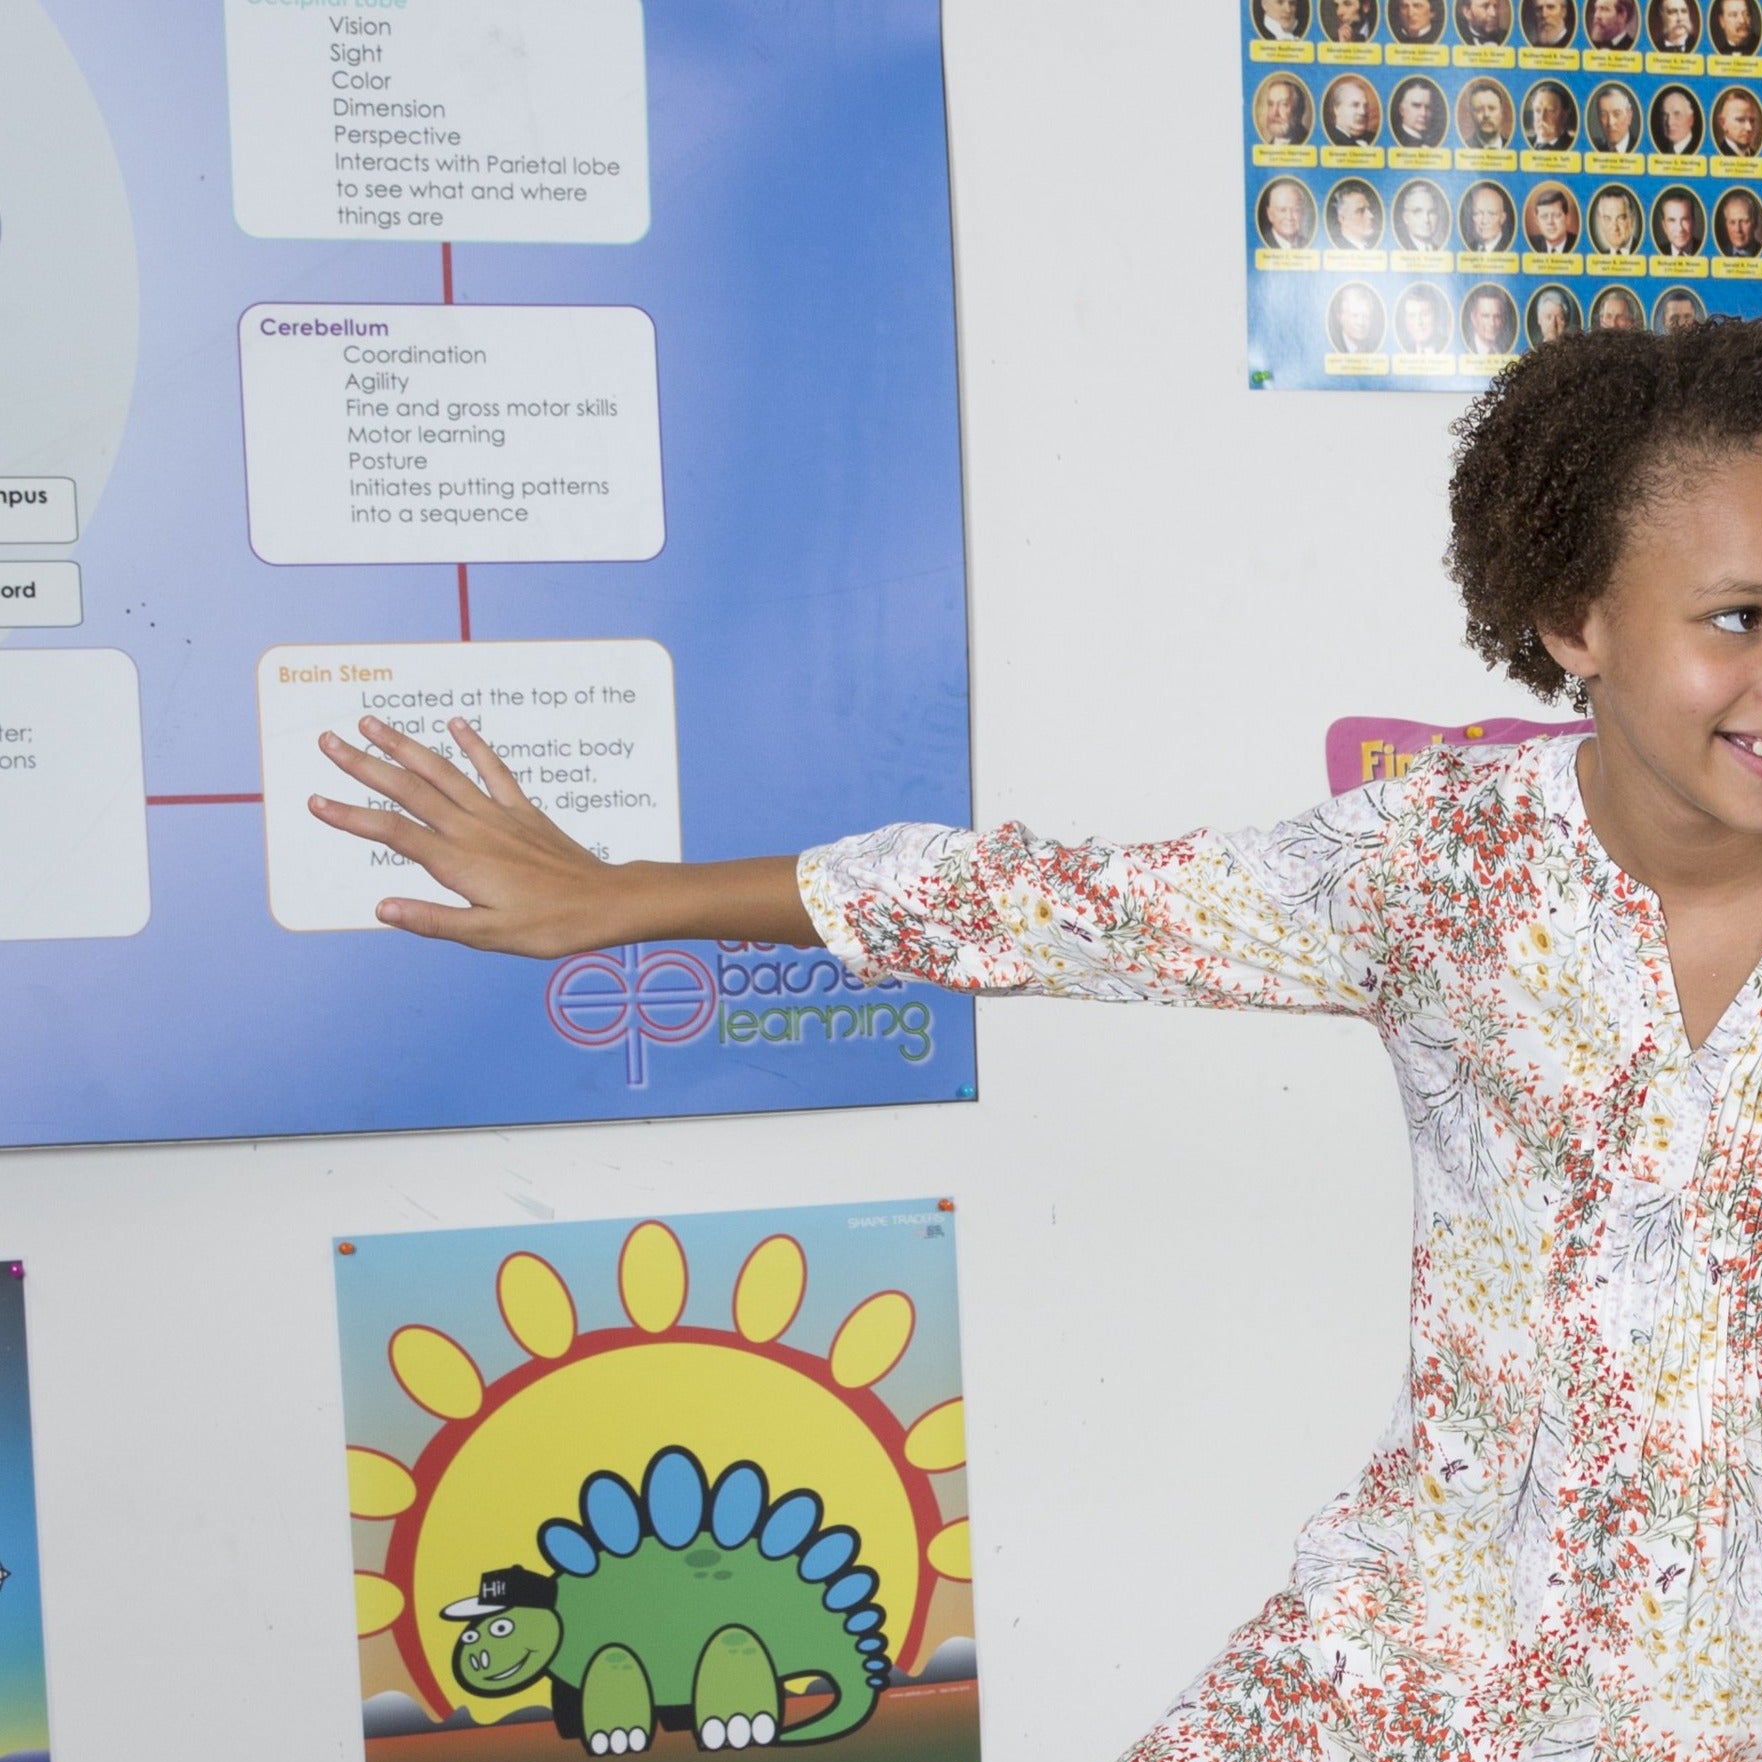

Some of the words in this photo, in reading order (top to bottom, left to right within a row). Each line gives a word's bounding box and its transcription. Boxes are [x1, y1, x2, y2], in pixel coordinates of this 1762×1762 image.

[329, 16, 391, 35] Vision
[331, 44, 382, 66] Sight
[332, 71, 391, 89] Color
[334, 98, 445, 118] Dimension
[335, 125, 460, 147] Perspective
[336, 153, 429, 172] Interacts
[436, 154, 479, 172] with
[488, 155, 566, 174] Parietal
[573, 157, 620, 175] lobe
[337, 180, 358, 197] to
[366, 184, 402, 198] see
[410, 182, 464, 199] what
[472, 184, 513, 200] and
[521, 184, 587, 201] where
[338, 207, 401, 229] things
[408, 212, 443, 226] are
[261, 318, 388, 336] Cerebellum
[344, 345, 486, 363] Coordination
[345, 372, 408, 394] Agility
[347, 399, 388, 416] Fine
[397, 400, 439, 416] and
[447, 403, 499, 421] gross
[507, 400, 570, 416] motor
[577, 399, 617, 416] skills
[348, 426, 411, 443] Motor
[419, 425, 505, 447] learning
[349, 452, 427, 470] Posture
[351, 479, 431, 496] Initiates
[439, 478, 514, 499] putting
[522, 478, 609, 498] patterns
[352, 505, 391, 523] into
[399, 509, 412, 522] a
[420, 508, 528, 525] sequence
[279, 666, 331, 683] Brain
[340, 665, 392, 682] Stem
[362, 690, 453, 708] Located
[461, 689, 482, 706] at
[490, 689, 524, 705] the
[532, 689, 567, 711] top
[575, 686, 594, 704] of
[602, 687, 635, 703] the
[432, 715, 482, 733] cd
[580, 739, 634, 758] body
[541, 766, 596, 783] beat,
[556, 790, 655, 812] digestion,
[718, 1000, 933, 1062] learning
[483, 1580, 506, 1598] Hi!
